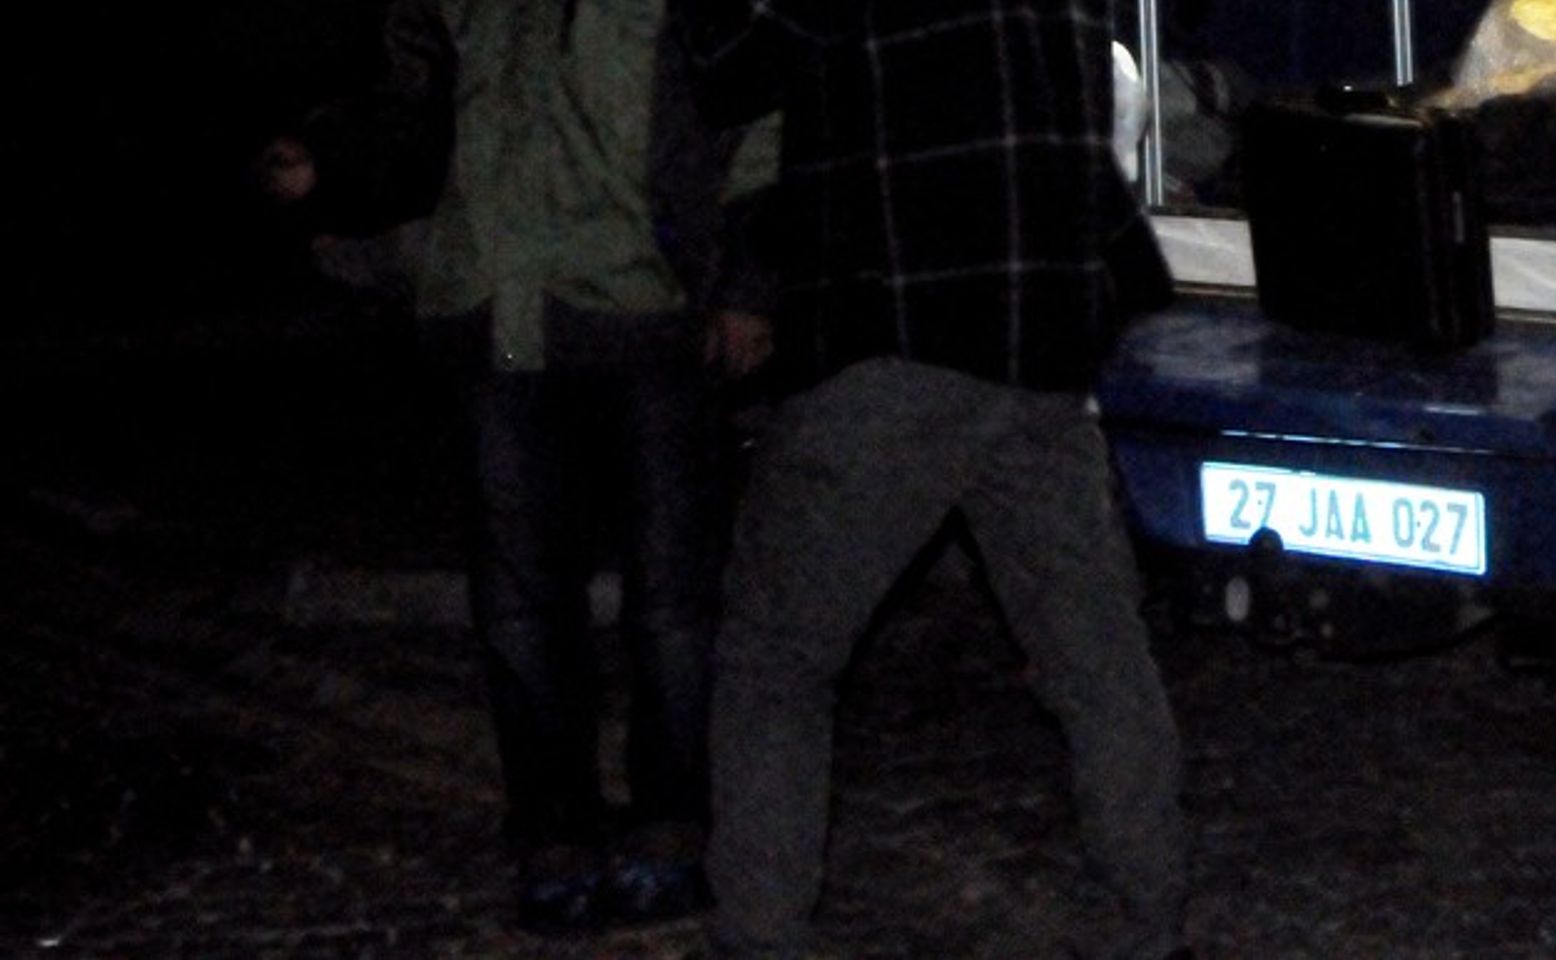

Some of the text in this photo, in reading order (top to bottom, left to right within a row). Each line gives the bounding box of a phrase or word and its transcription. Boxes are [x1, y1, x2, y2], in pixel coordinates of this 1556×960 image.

[1228, 478, 1469, 556] 27 JAA 027
